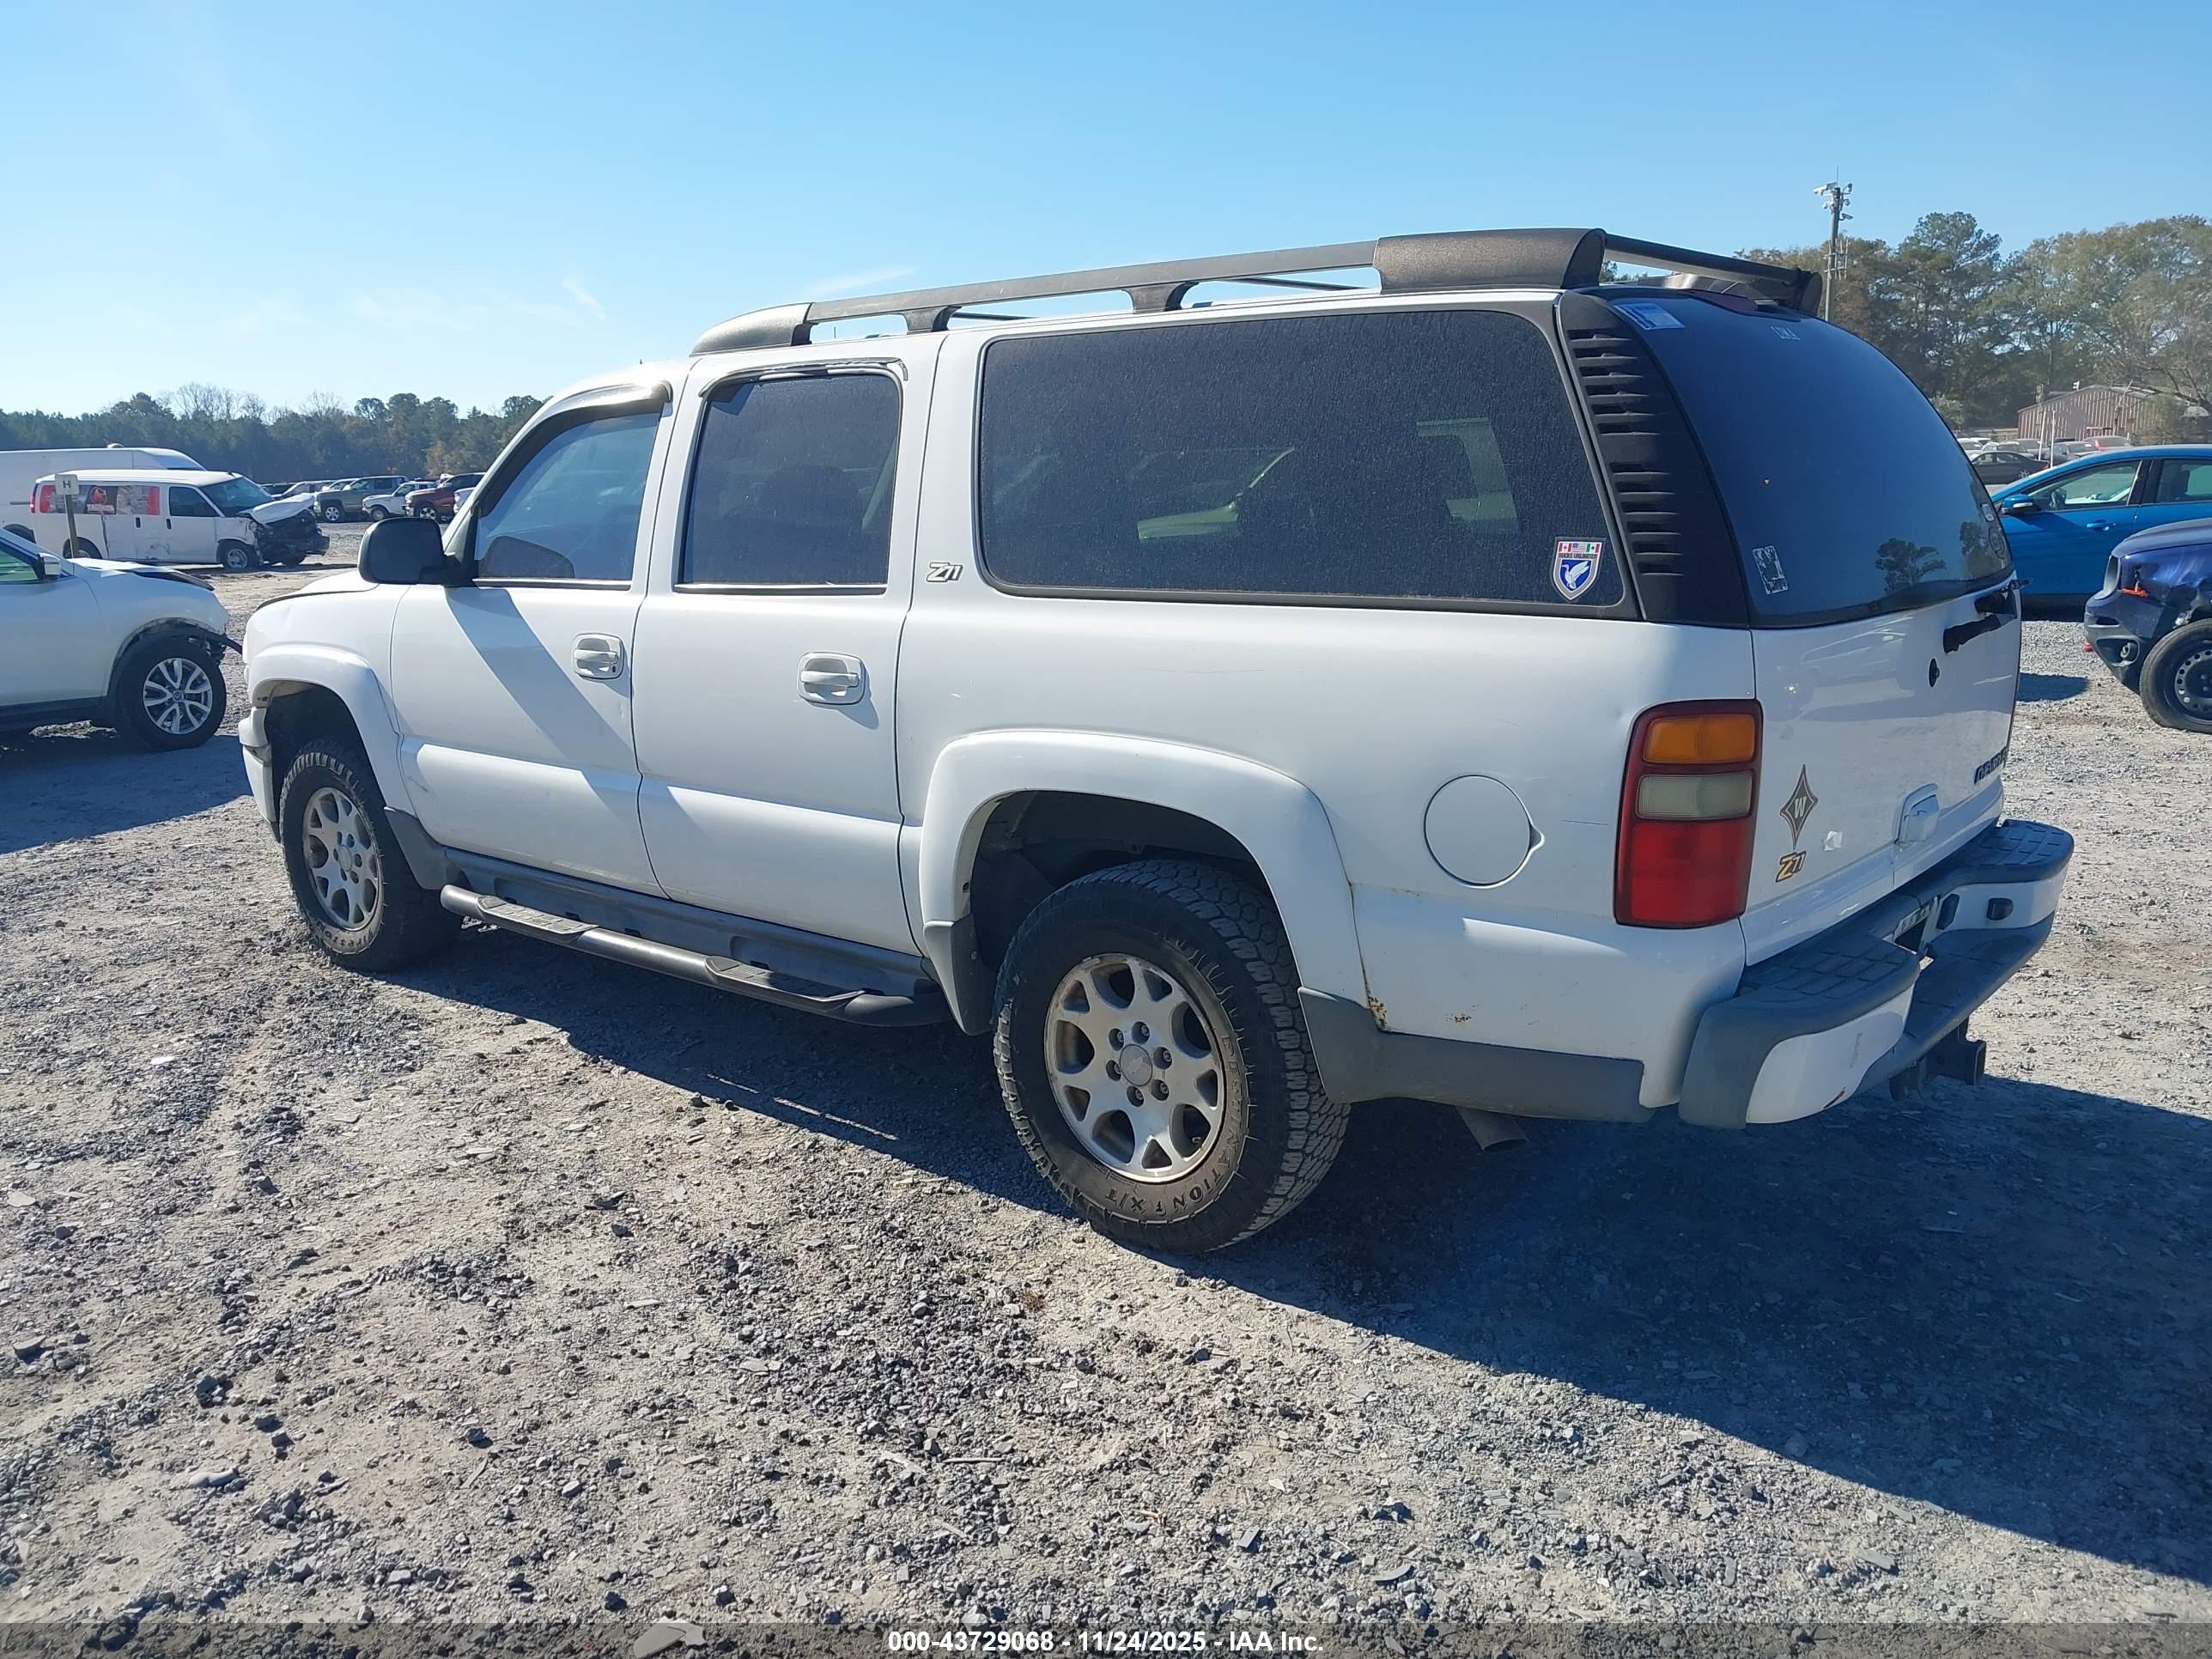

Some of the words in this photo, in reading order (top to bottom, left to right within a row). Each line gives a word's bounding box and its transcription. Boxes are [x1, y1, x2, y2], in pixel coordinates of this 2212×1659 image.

[63, 480, 71, 489] H
[927, 562, 963, 582] Z71
[1794, 796, 1807, 818] W
[1775, 851, 1807, 883] Z71
